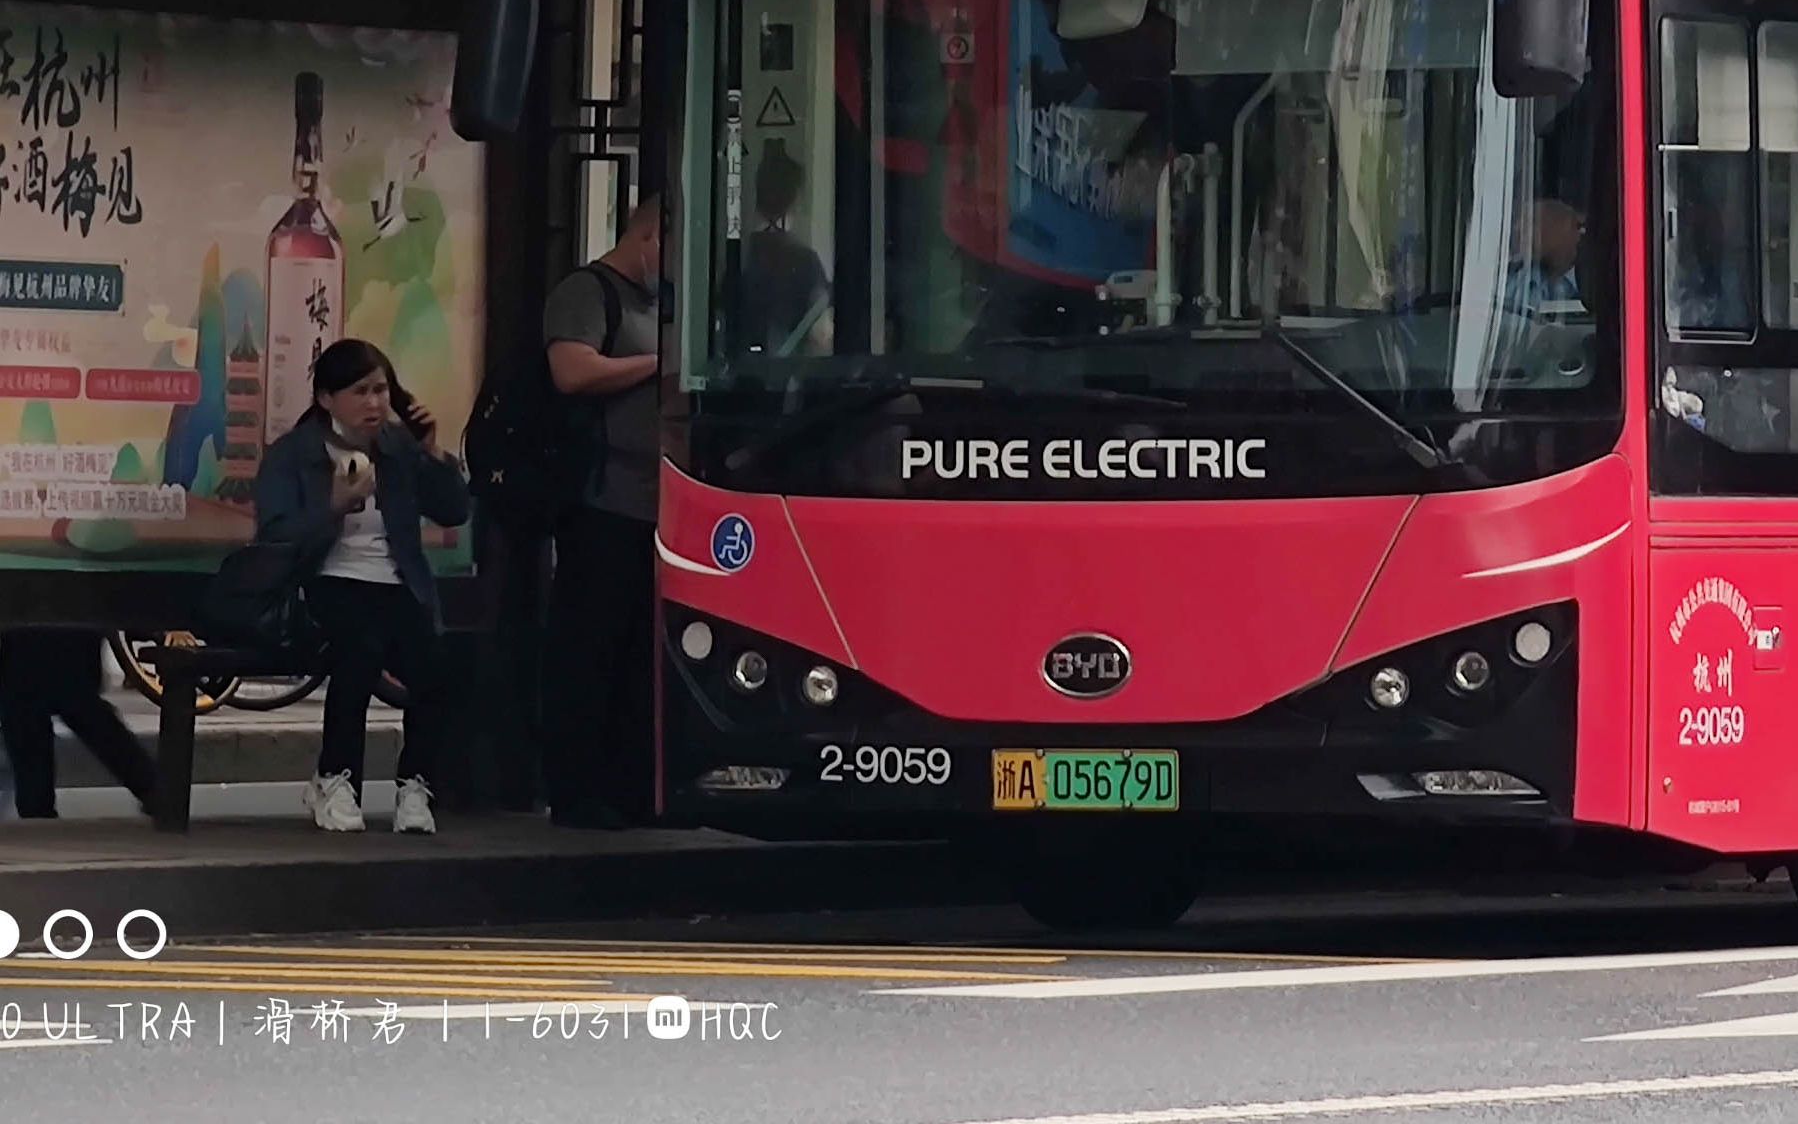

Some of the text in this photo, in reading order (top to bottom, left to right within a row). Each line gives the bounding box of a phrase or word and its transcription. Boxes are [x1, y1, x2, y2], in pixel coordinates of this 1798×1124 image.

[902, 439, 1266, 479] PURE ELECTRIC
[1051, 652, 1120, 678] BYD
[1679, 706, 1744, 746] 2-9059
[820, 746, 951, 785] 2-9059
